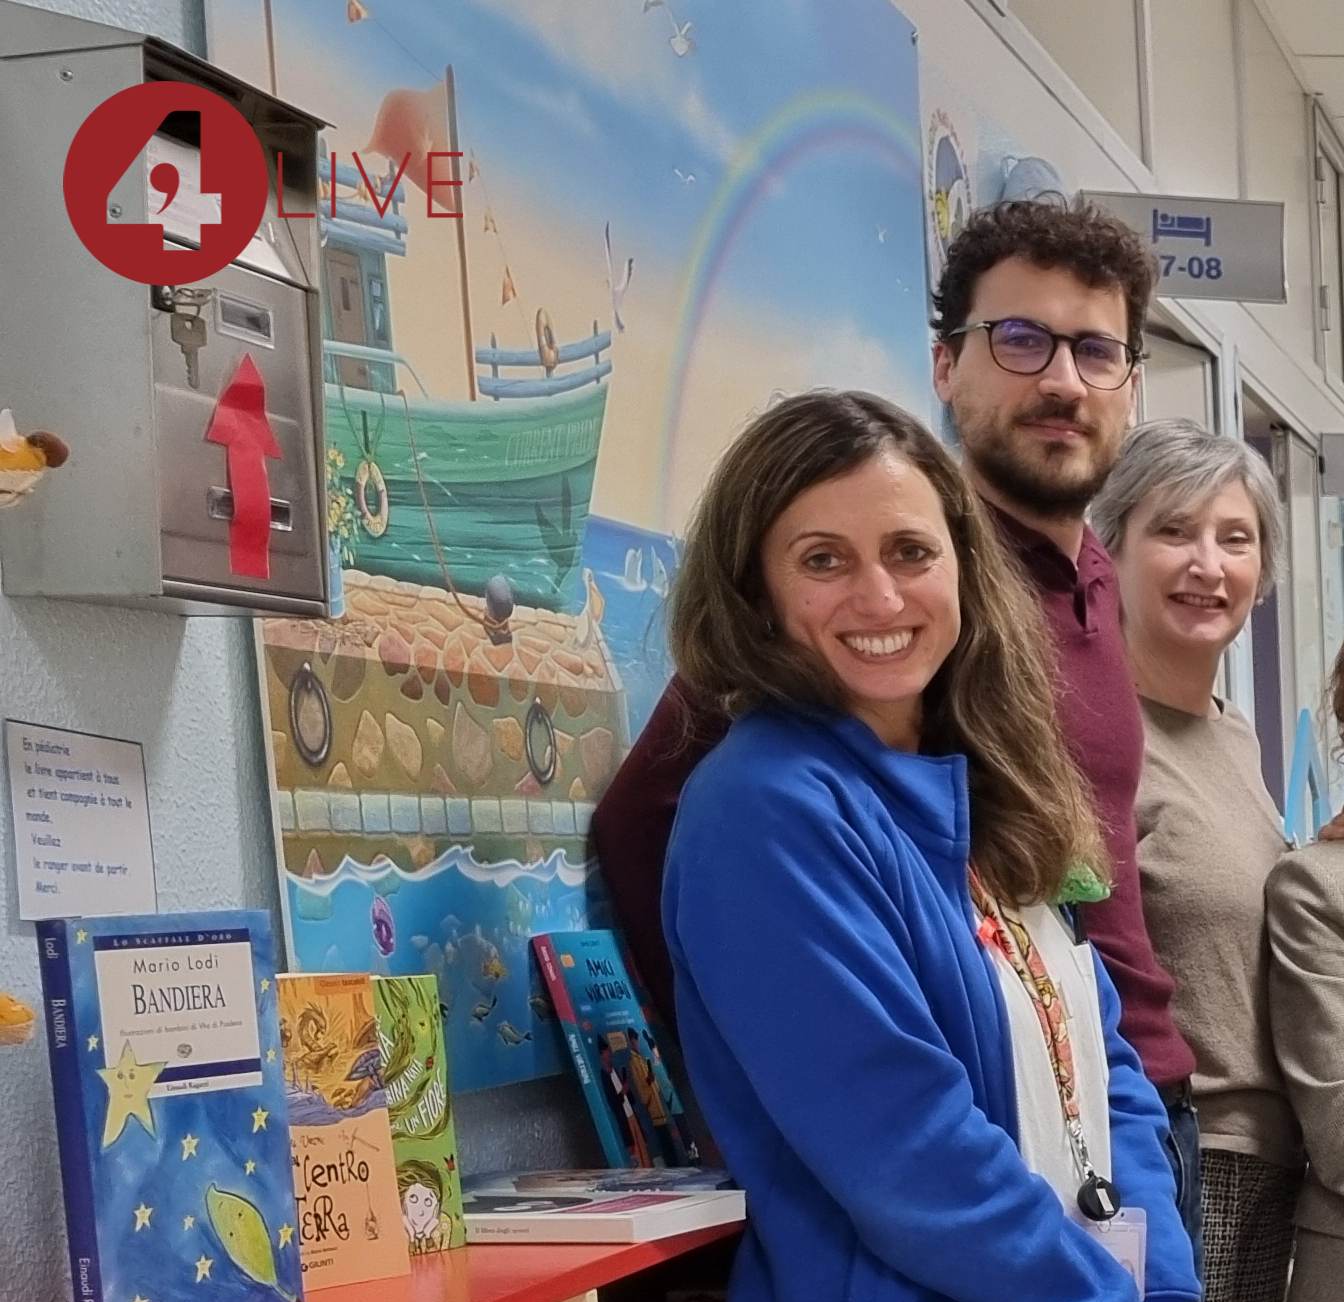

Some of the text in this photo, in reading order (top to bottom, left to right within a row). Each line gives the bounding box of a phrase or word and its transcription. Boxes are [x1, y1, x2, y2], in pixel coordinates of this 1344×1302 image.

[1159, 255, 1222, 280] 7-08
[22, 737, 34, 751] En
[45, 937, 57, 959] Lodi
[133, 954, 219, 974] Mario Lodi
[131, 983, 226, 1015] BANDIERA
[51, 1000, 67, 1049] BANDIERA
[79, 1257, 93, 1295] Einaudi
